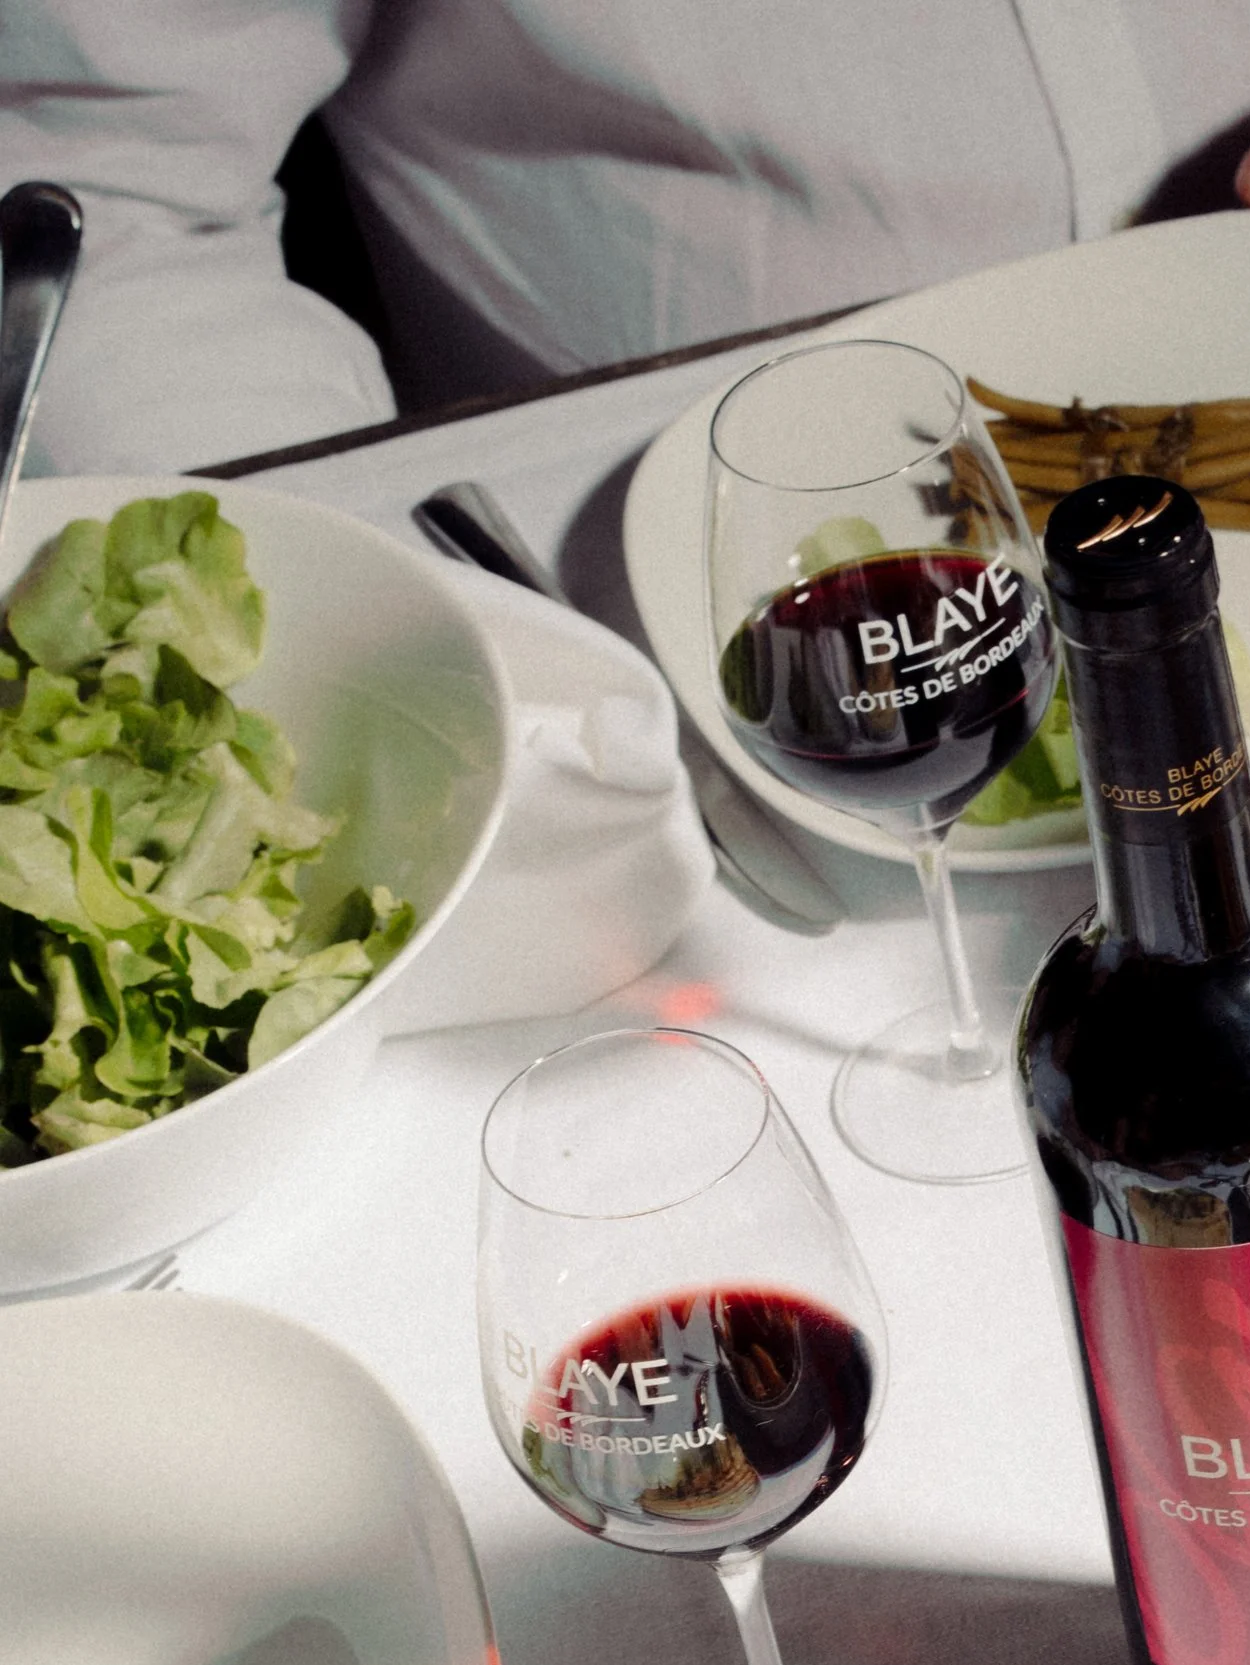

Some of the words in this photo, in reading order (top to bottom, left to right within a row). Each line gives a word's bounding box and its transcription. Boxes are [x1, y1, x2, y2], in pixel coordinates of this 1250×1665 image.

[858, 552, 1019, 665] BLAYE
[839, 686, 919, 714] CÔTES
[923, 673, 957, 700] DE
[959, 595, 1045, 685] BORDEAUX
[1167, 746, 1225, 783] BLAYE
[1100, 782, 1162, 805] CÔTES
[1168, 782, 1195, 802] DE
[503, 1330, 678, 1407] BLAYE
[545, 1421, 575, 1446] DE
[579, 1422, 728, 1456] BORDEAUX
[1159, 1498, 1246, 1528] CÔTES
